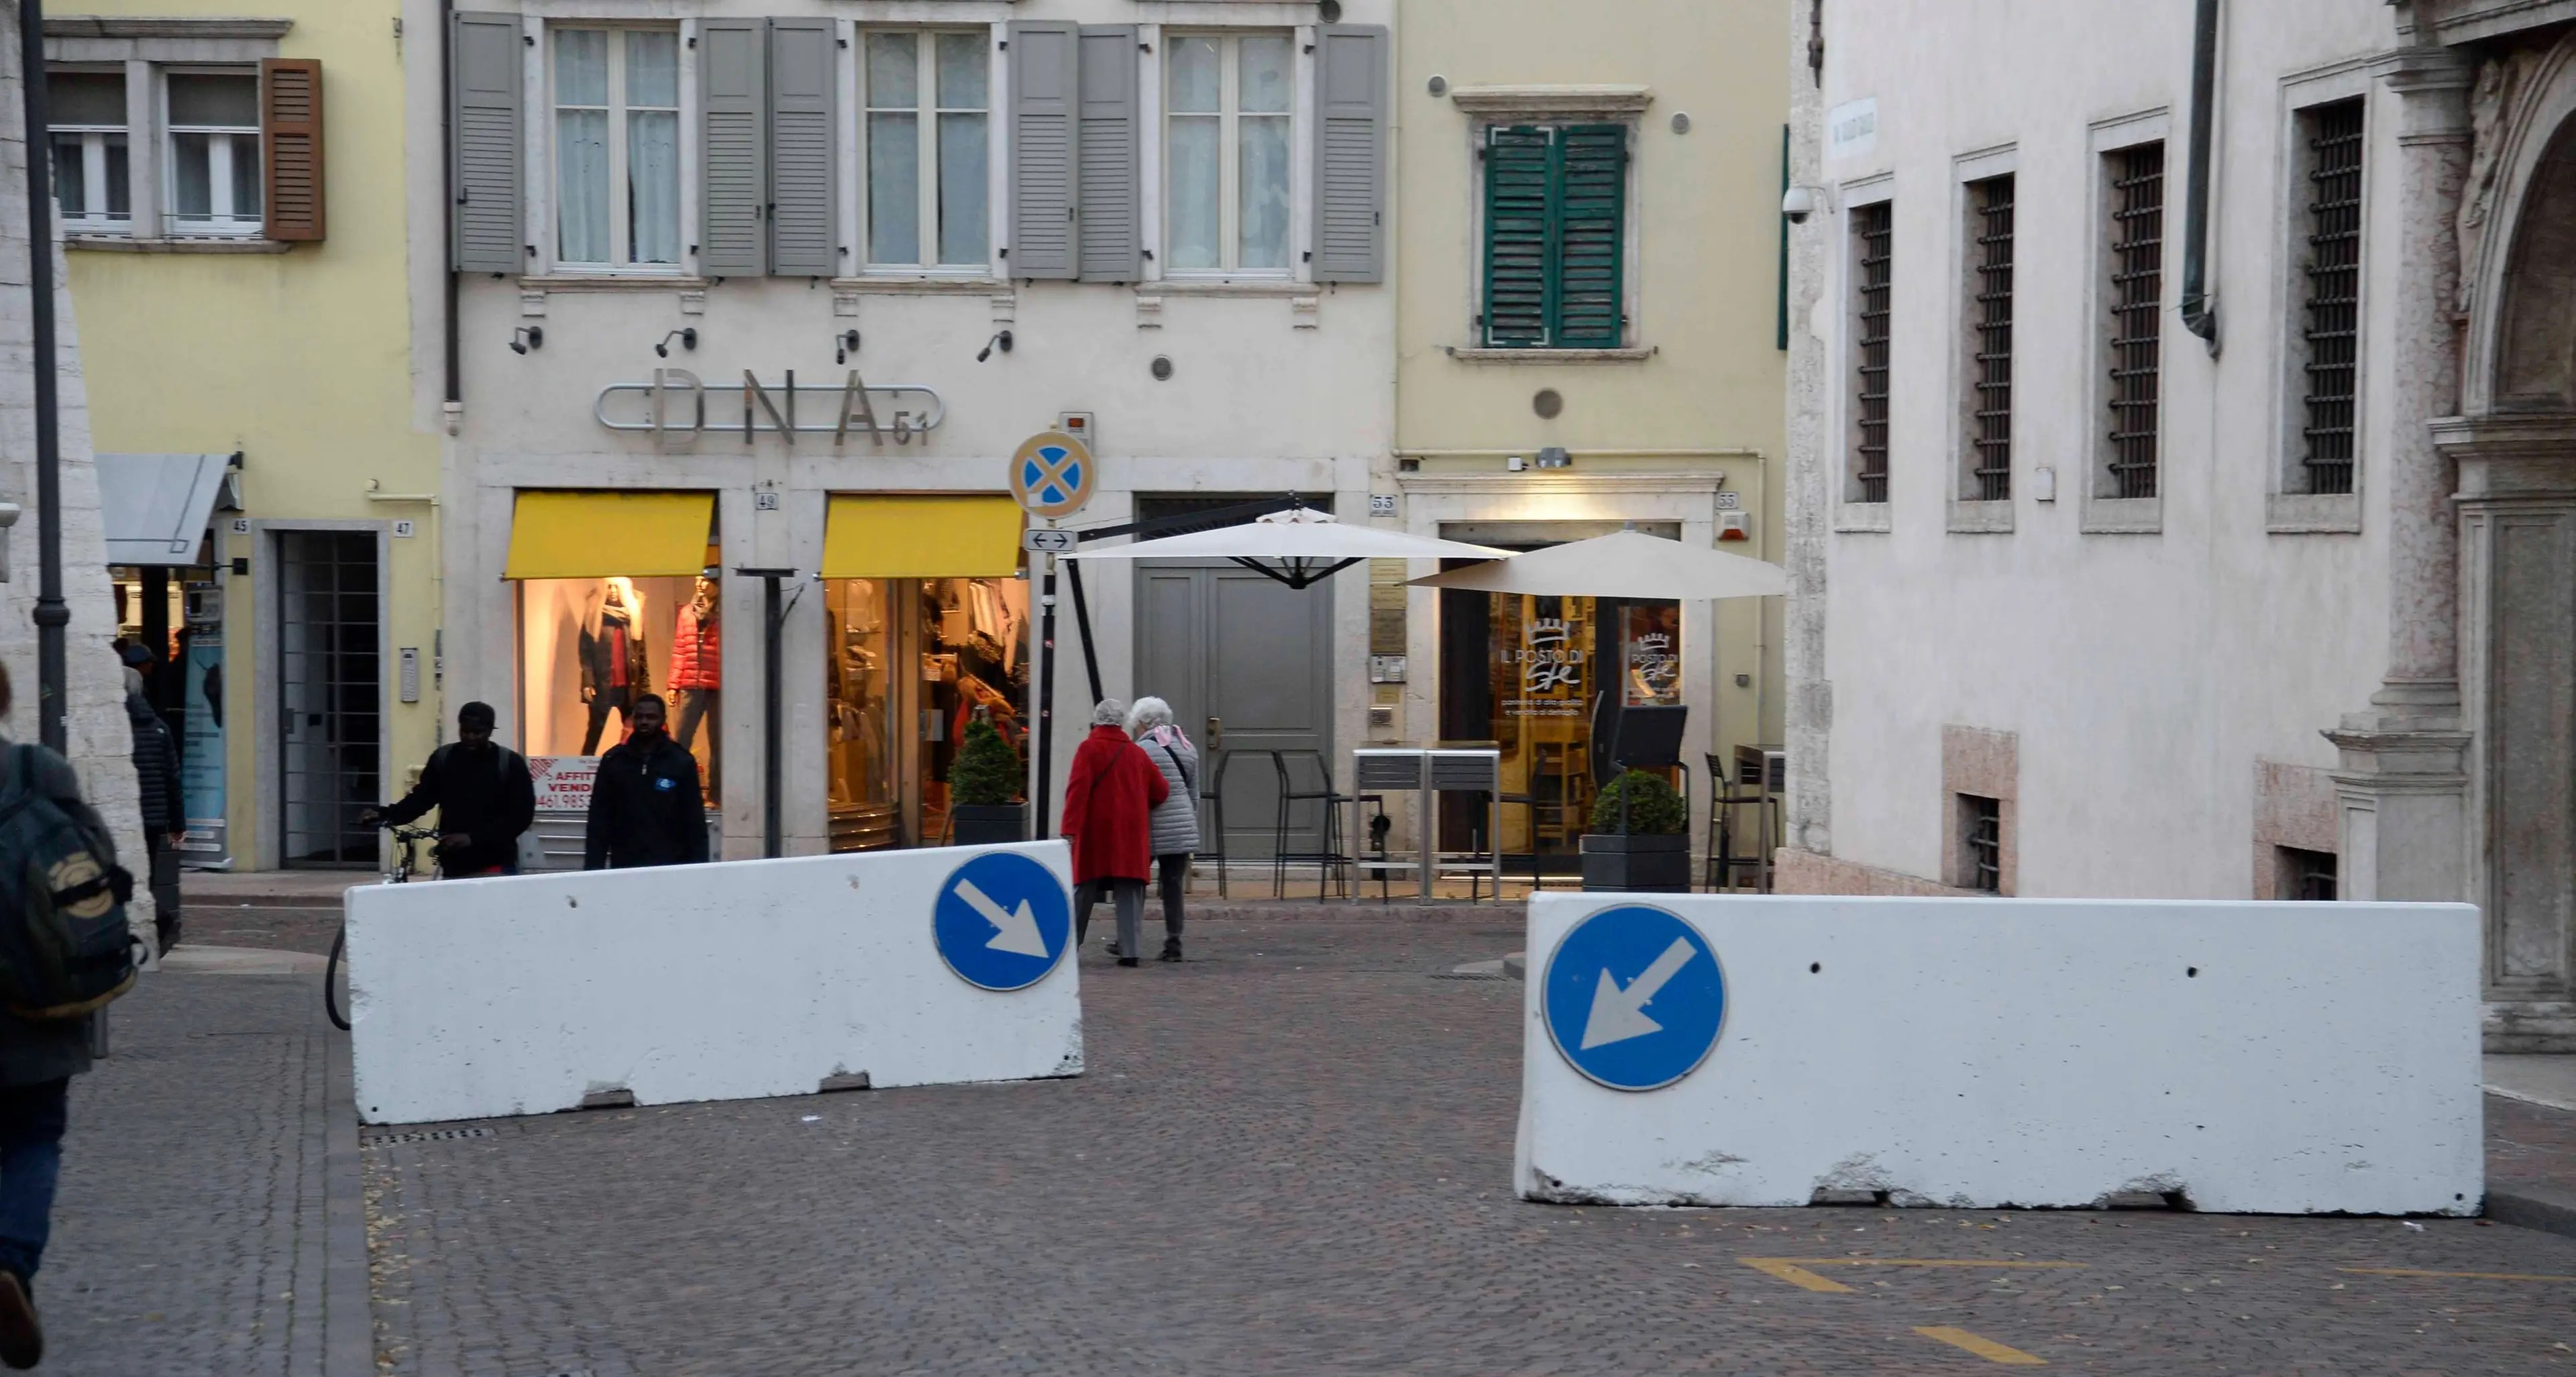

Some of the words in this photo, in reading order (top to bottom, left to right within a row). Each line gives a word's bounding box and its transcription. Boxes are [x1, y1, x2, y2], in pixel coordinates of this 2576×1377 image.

[653, 368, 883, 446] DNA
[893, 410, 928, 447] 51
[759, 495, 773, 508] 49
[233, 520, 246, 532] 45
[396, 523, 409, 534] 47
[1515, 649, 1567, 663] POSTO
[1570, 650, 1584, 663] DI
